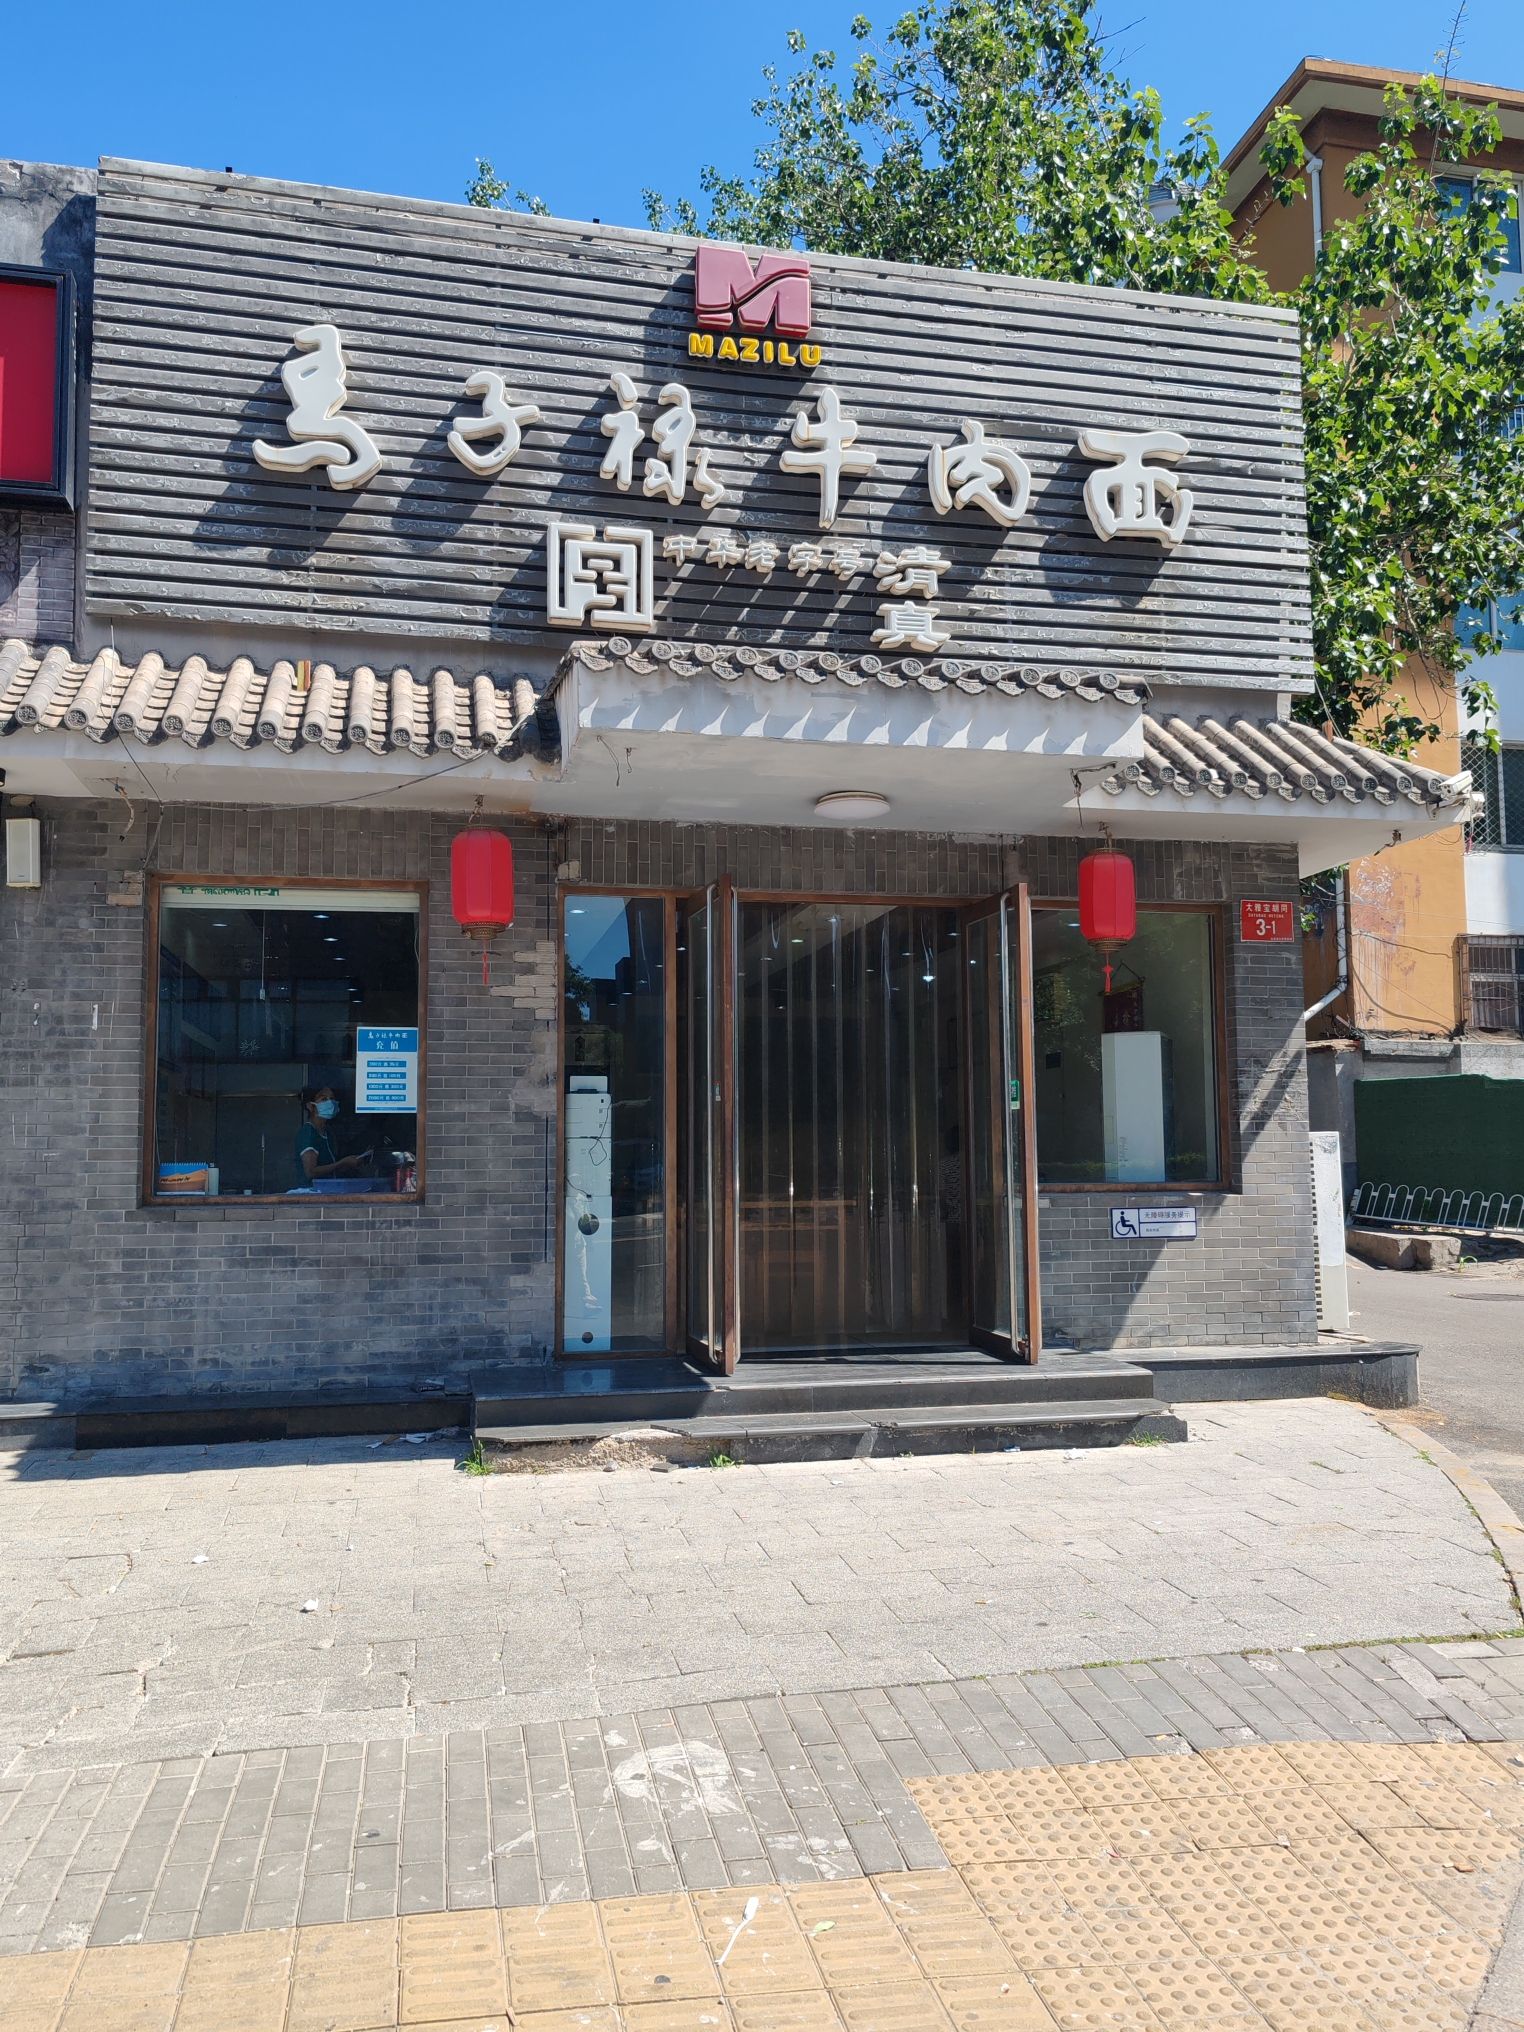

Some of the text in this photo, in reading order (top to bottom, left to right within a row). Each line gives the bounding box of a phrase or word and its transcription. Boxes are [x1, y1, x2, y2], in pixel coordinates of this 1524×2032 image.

[688, 332, 822, 367] MAZILU
[870, 546, 953, 652] 清真
[1255, 918, 1276, 936] 3-1
